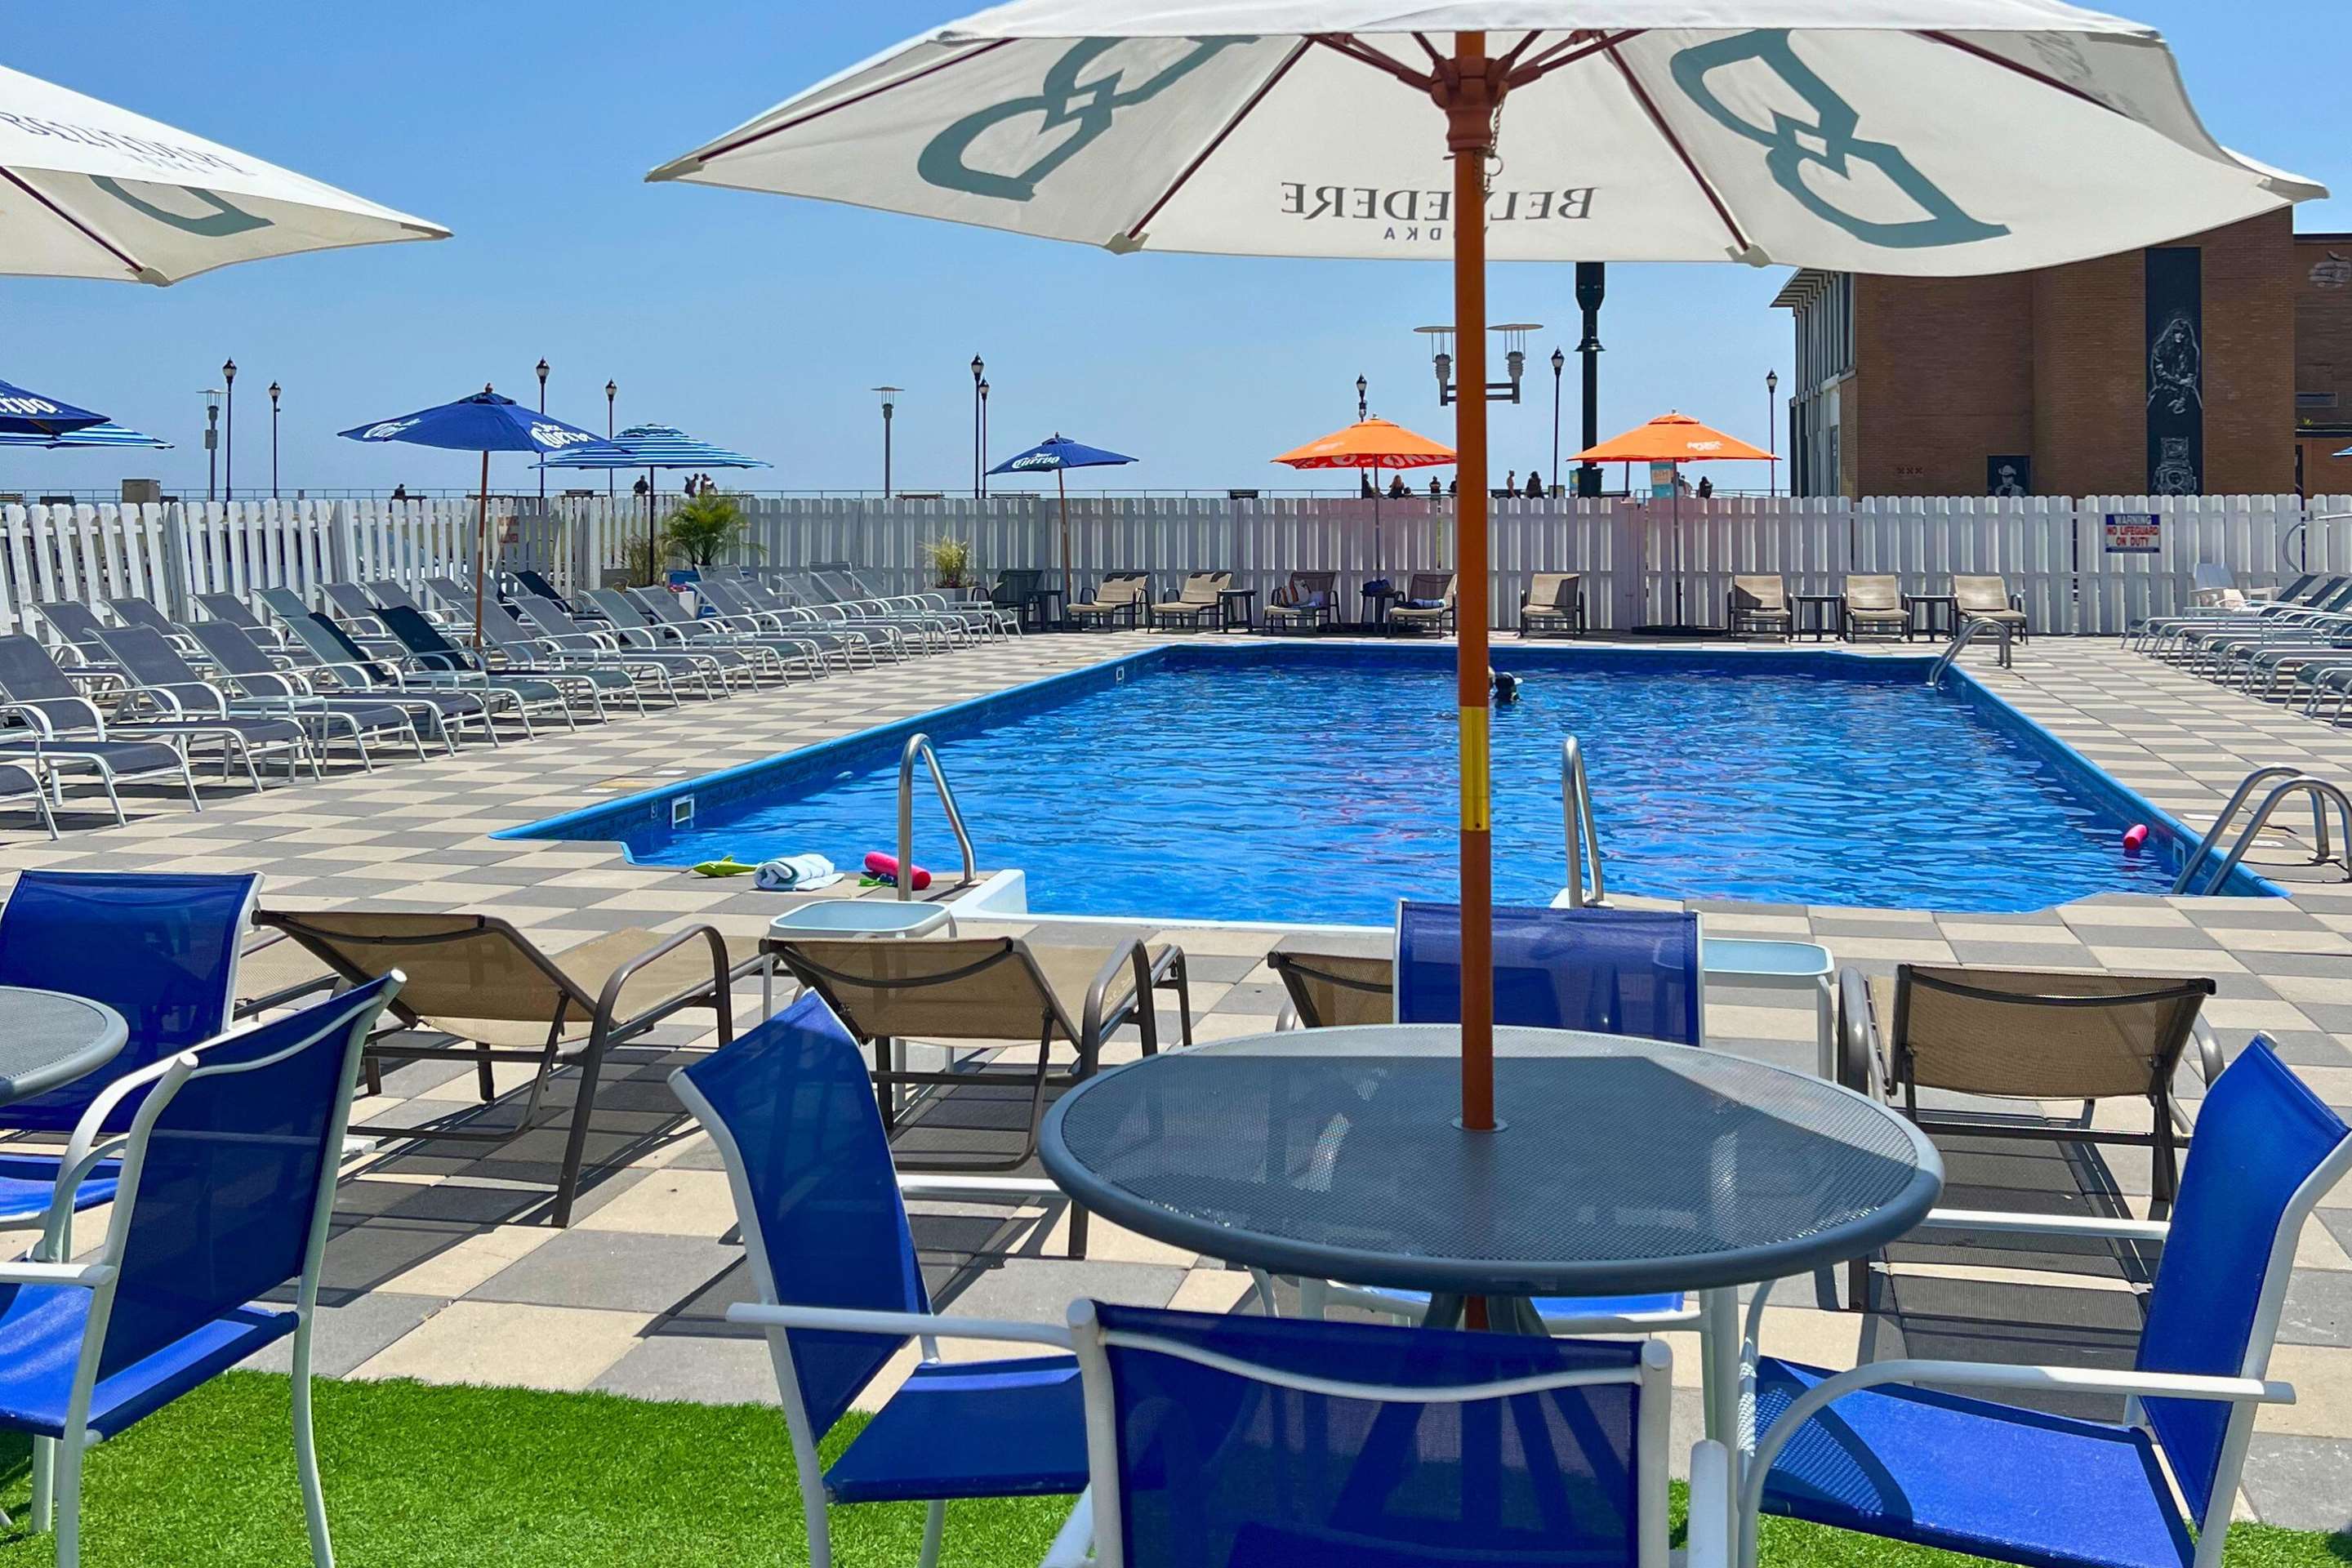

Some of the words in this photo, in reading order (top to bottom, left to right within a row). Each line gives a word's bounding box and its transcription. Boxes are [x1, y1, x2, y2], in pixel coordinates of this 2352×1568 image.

[2114, 514, 2152, 524] WARNING
[2106, 526, 2118, 536] NO
[2120, 526, 2158, 536] LIFEGUARD
[2116, 537, 2127, 546] ON
[2130, 537, 2149, 546] DUTY
